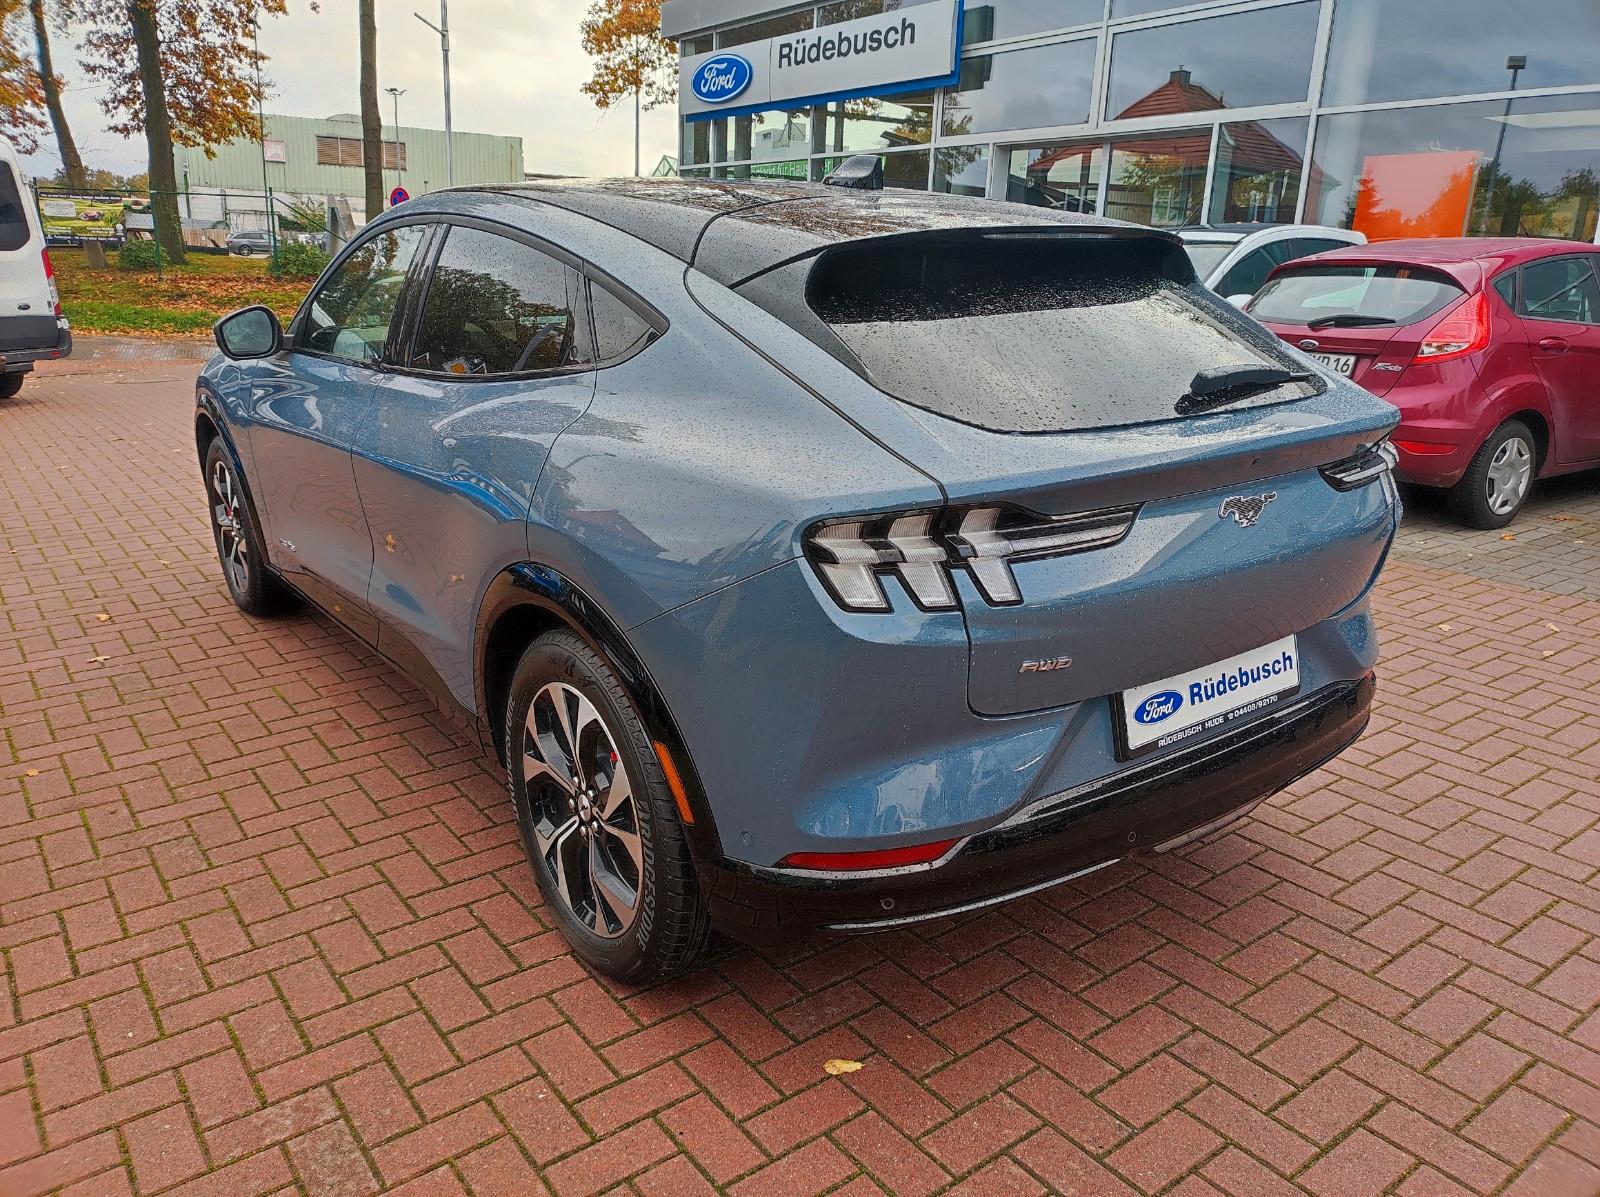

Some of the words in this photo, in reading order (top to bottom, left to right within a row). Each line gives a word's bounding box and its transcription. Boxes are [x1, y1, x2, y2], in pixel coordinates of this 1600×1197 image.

[700, 62, 736, 93] Ford
[778, 18, 916, 68] Rüdebusch
[1018, 655, 1073, 674] AWD
[1143, 695, 1175, 721] Ford
[1188, 651, 1294, 706] Rüdebusch
[1158, 724, 1202, 748] RÜDEBUSCH
[1205, 715, 1225, 729] HUDE
